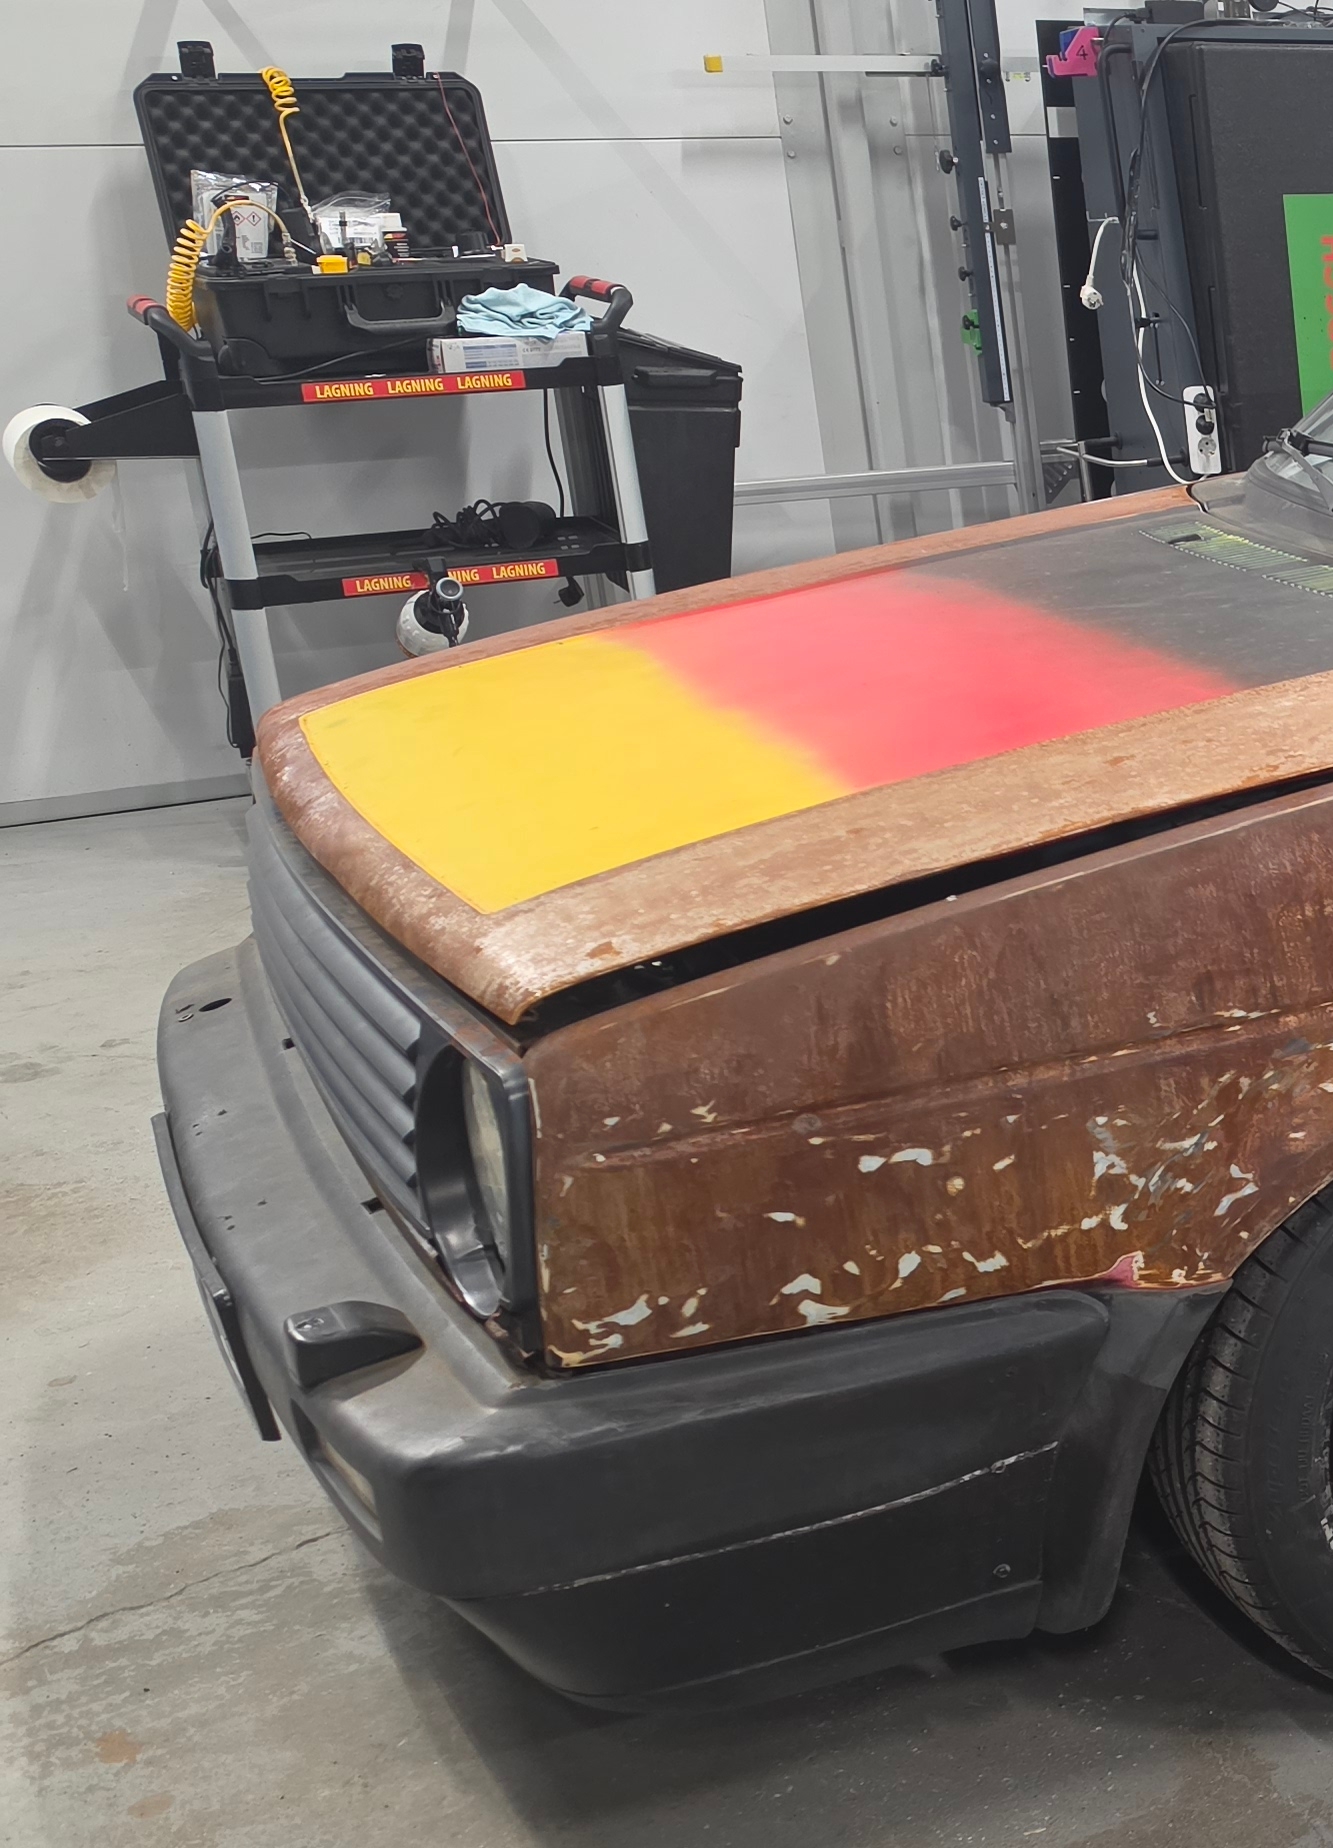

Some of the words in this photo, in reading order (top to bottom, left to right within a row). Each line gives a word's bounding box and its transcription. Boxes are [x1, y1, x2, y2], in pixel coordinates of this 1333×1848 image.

[1076, 45, 1088, 60] 4
[315, 382, 374, 398] LAGNING
[387, 378, 444, 394] LAGNING
[457, 373, 512, 389] LAGNING
[356, 575, 411, 592] LAGNING
[492, 563, 546, 579] LAGNING
